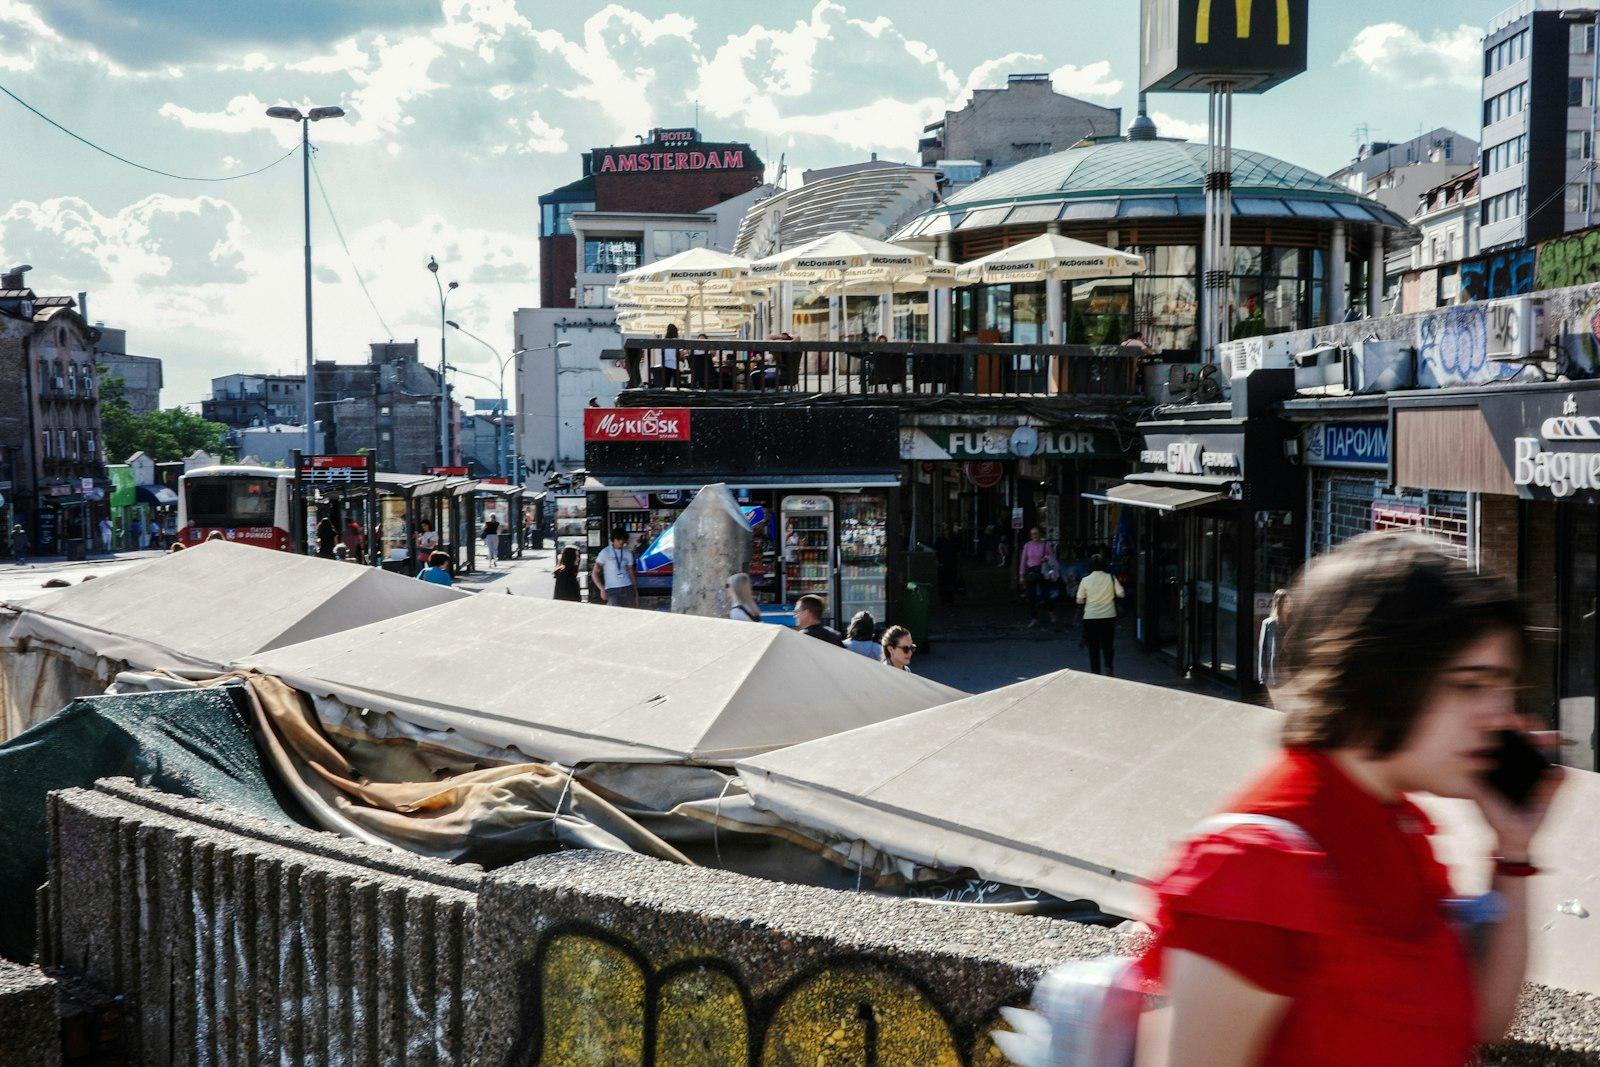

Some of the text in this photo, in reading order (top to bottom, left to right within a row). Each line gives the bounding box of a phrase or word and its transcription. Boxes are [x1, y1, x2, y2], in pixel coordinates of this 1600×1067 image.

[660, 131, 693, 141] HOTEL
[600, 150, 744, 173] AMSTERDAM
[797, 258, 847, 267] McDonald's
[987, 261, 1035, 272] McDonald's
[1058, 258, 1104, 268] McDonald's
[670, 269, 718, 279] McDonald's
[595, 413, 624, 437] Moj
